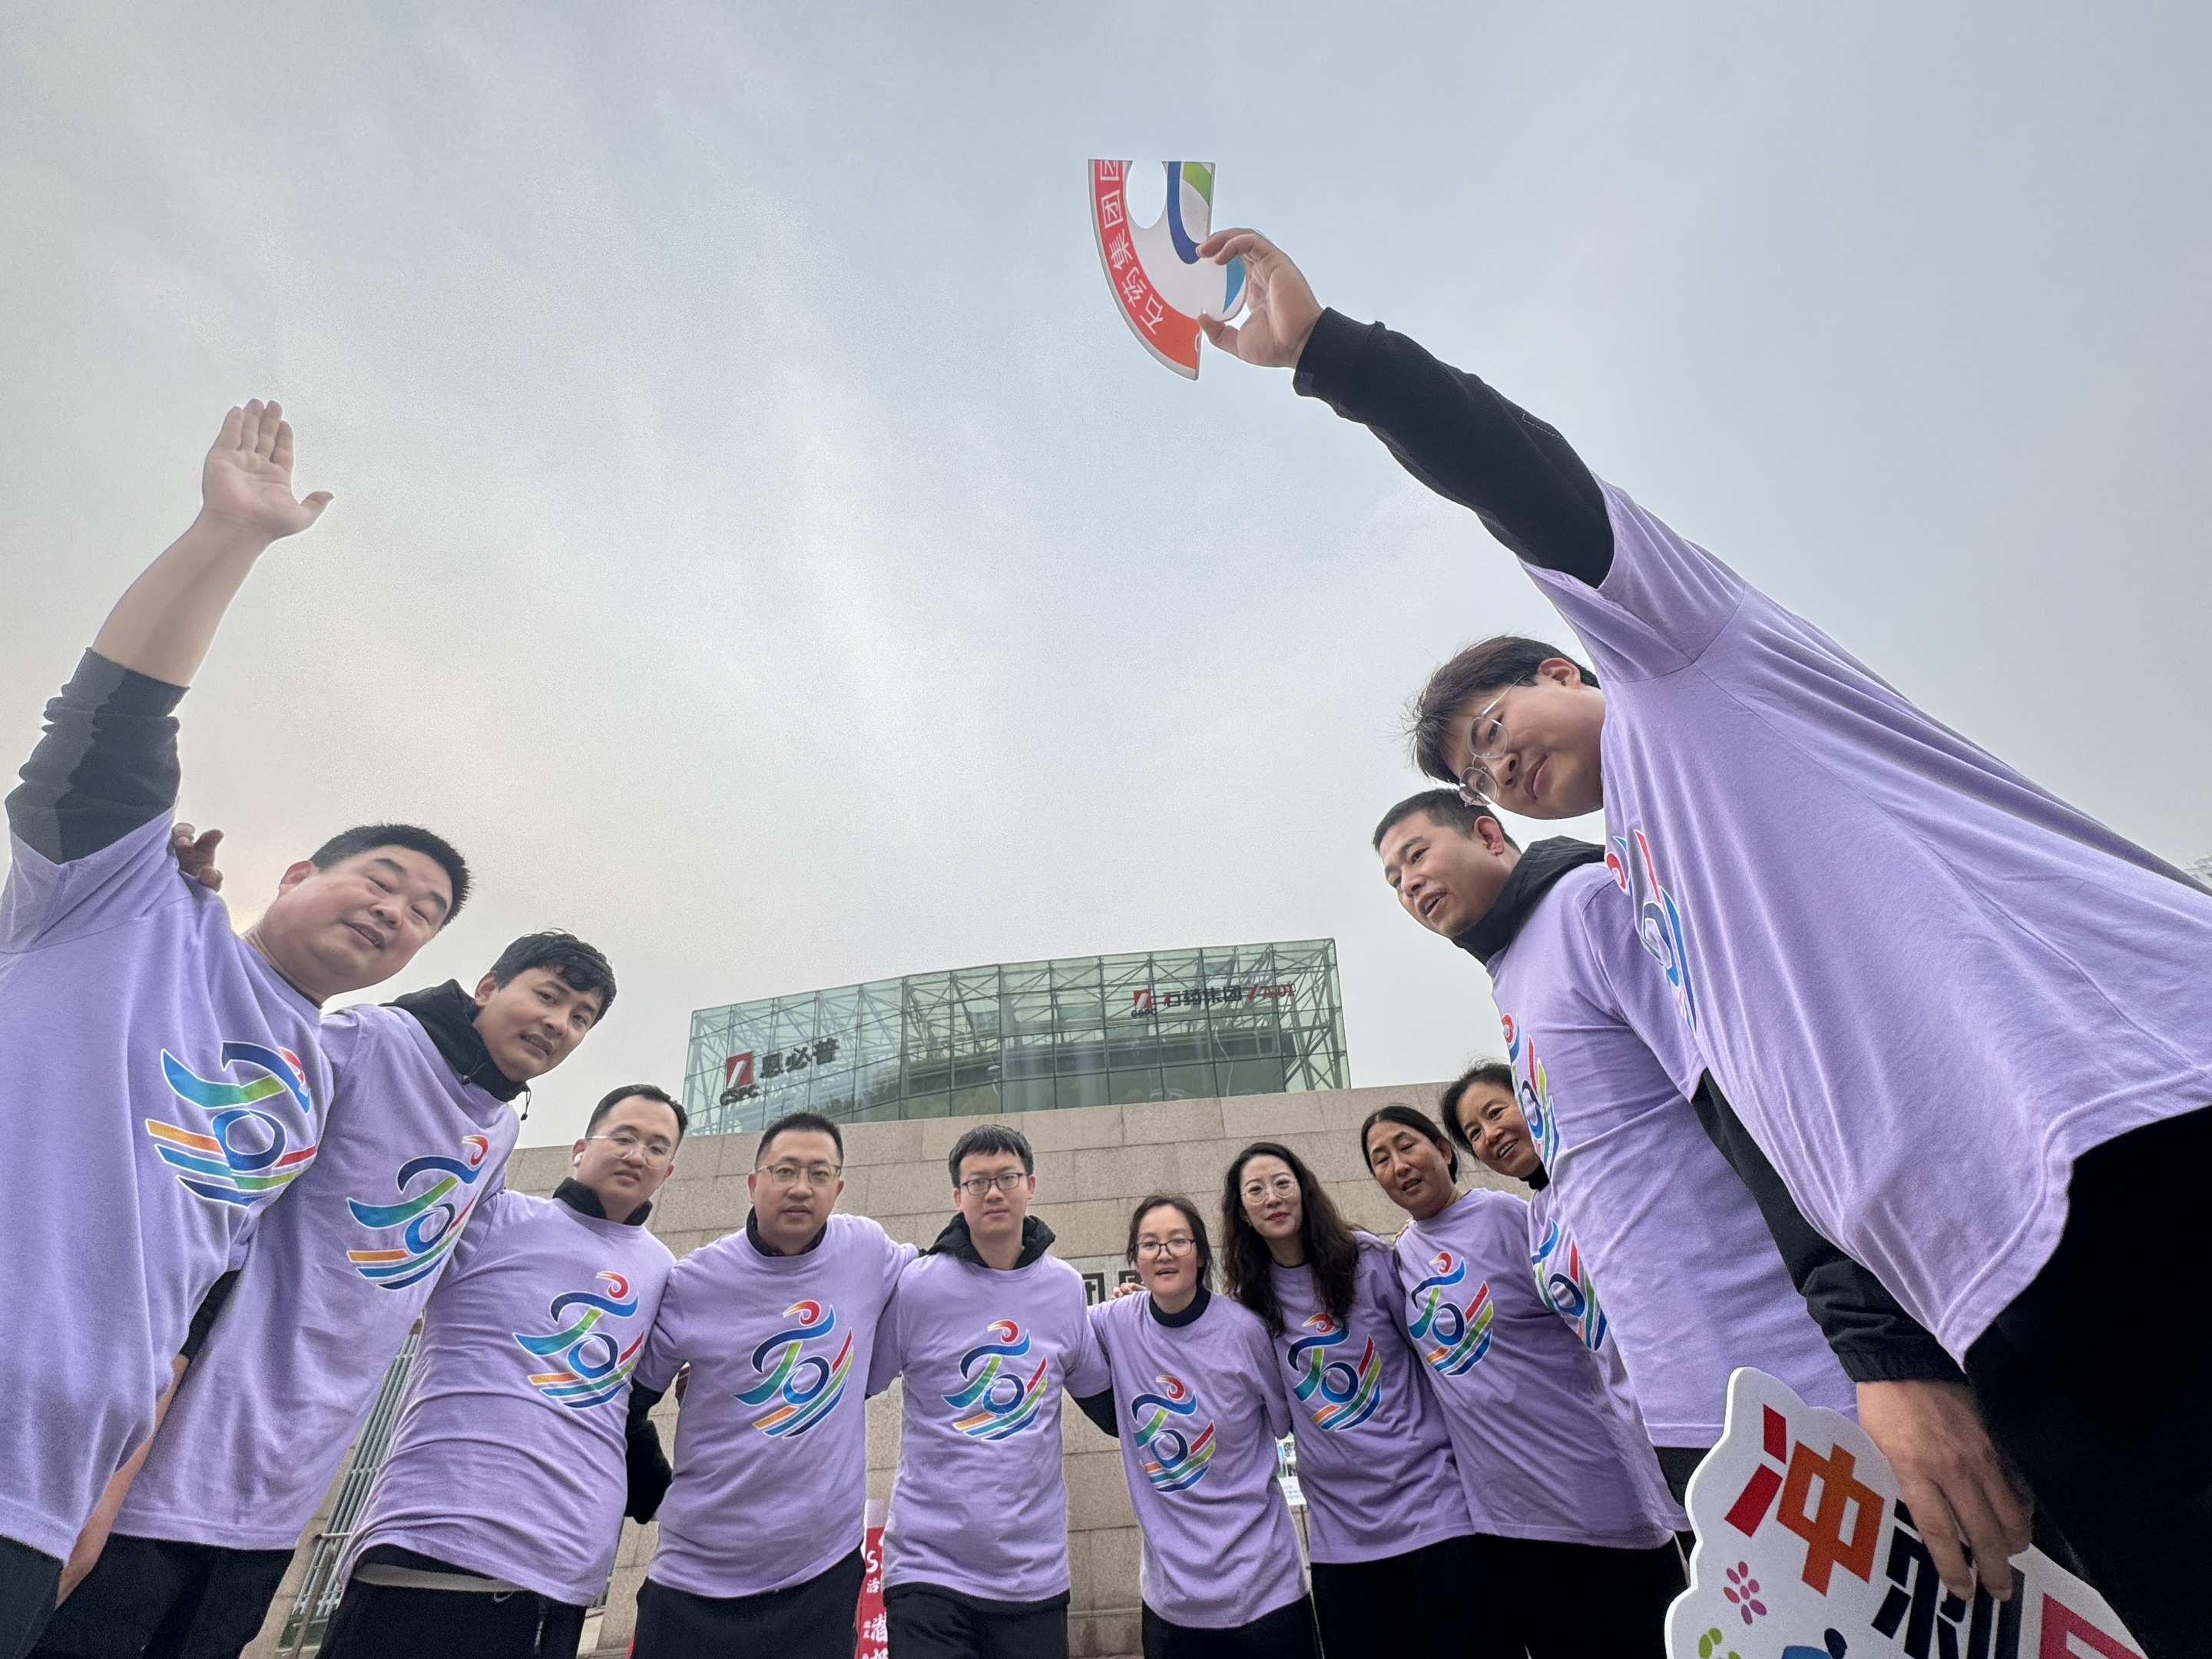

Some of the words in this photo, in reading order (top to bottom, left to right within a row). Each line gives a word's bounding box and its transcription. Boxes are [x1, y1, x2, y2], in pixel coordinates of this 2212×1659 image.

[760, 1038, 840, 1079] 恩必普
[720, 1084, 760, 1106] CSPC
